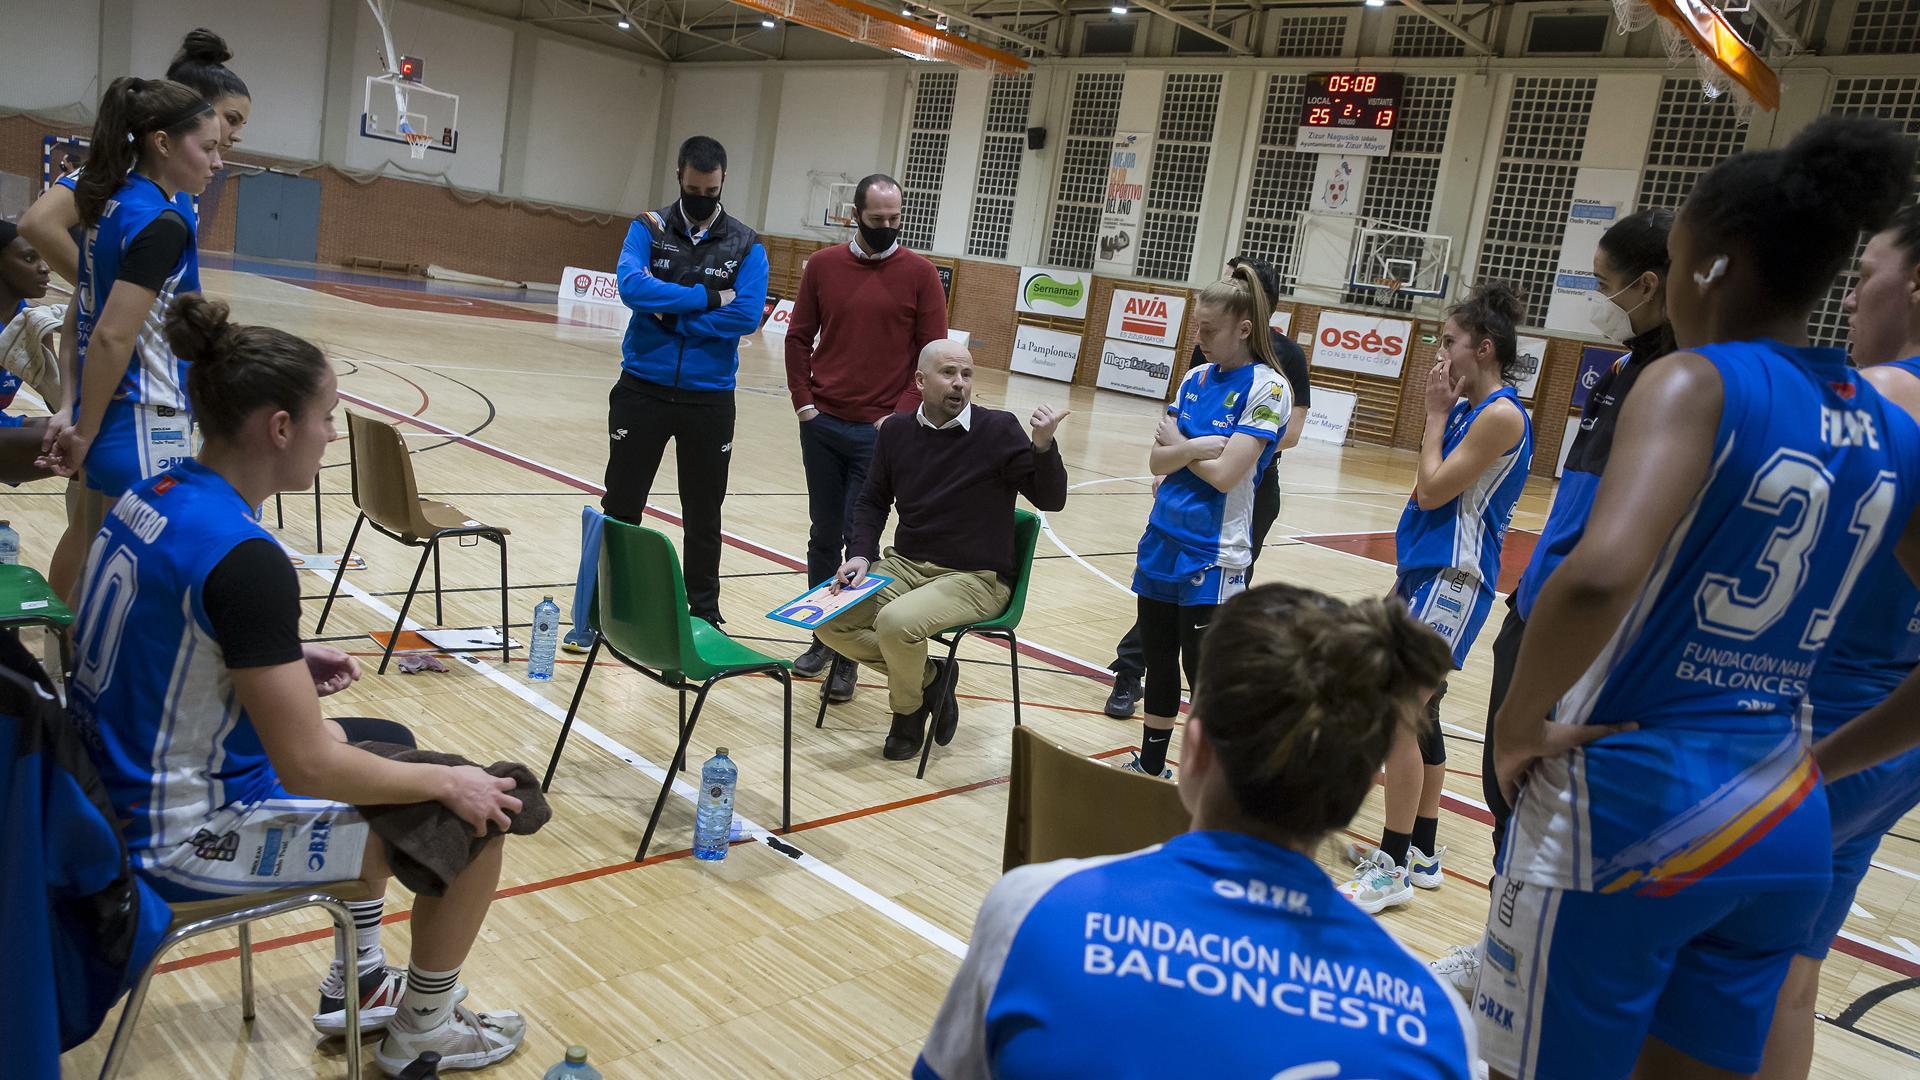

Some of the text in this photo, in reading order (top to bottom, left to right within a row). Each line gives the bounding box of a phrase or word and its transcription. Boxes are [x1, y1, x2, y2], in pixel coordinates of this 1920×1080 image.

[1329, 76, 1376, 92] 05:08
[1307, 96, 1393, 106] LOCAL VISITANTE
[1309, 108, 1330, 124] 25
[1376, 110, 1392, 126] 13
[1308, 131, 1325, 139] Zizur
[1327, 132, 1360, 141] Nagusiko
[1363, 143, 1386, 151] Mayor
[1112, 151, 1136, 168] MEJOR
[1108, 183, 1143, 200] DEPORTIVO
[1105, 198, 1132, 215] DEL AÑO
[1033, 283, 1079, 297] Sernaman
[1127, 332, 1144, 340] ZIZUR
[1144, 335, 1166, 344] MAYOR
[1016, 339, 1077, 359] La Pamplonesa
[1104, 351, 1171, 375] MegaCalzado
[1311, 411, 1327, 420] Udala
[1321, 419, 1343, 431] Mayor
[1693, 446, 1898, 651] 31
[1682, 641, 1777, 674] FUNDACIÓN
[1084, 912, 1427, 1016] FUNDACIÓN NAVARRA
[1083, 944, 1428, 1047] BALONCESTO
[1486, 998, 1515, 1030] BZK
